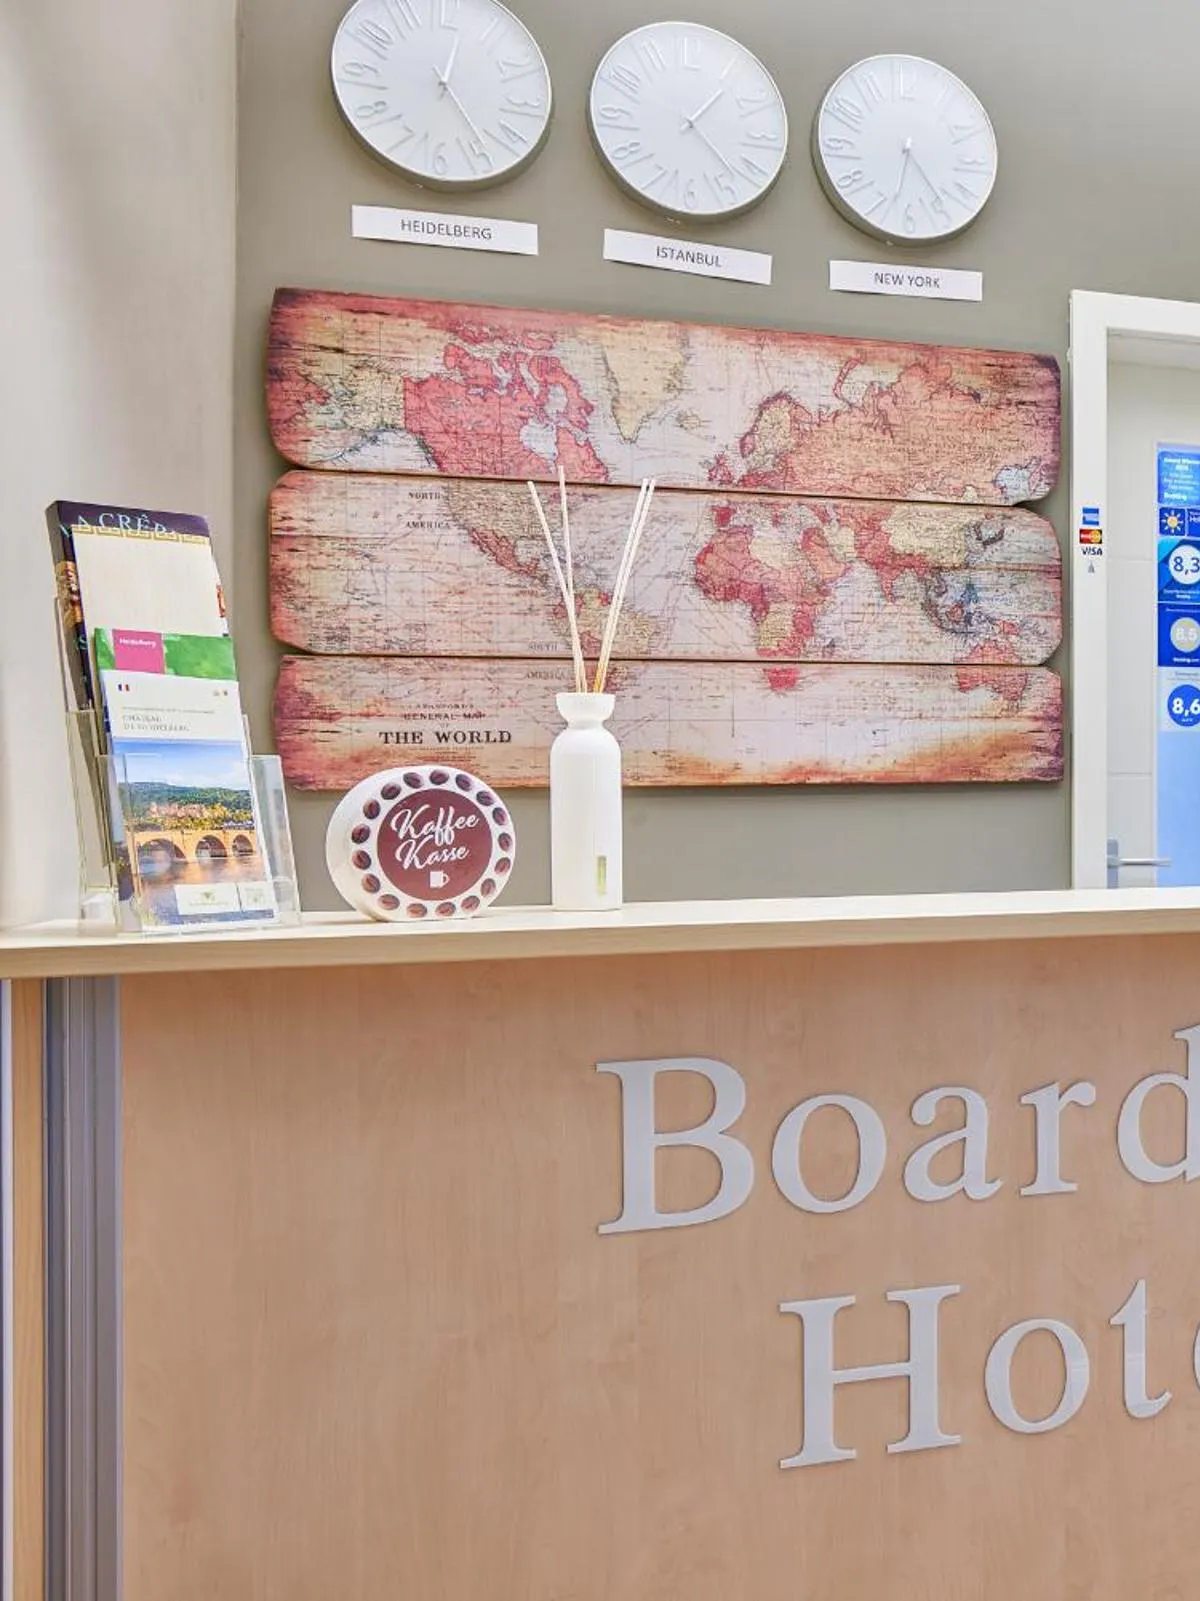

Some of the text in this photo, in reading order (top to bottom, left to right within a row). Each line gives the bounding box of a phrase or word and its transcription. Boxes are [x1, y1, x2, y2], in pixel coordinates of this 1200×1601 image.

[400, 218, 493, 241] HEIDELBERG
[656, 244, 722, 268] ISTANBUL
[874, 271, 941, 289] NEW YORK
[98, 512, 180, 536] CRÊP
[1081, 546, 1103, 556] VISA
[1173, 556, 1200, 575] 8,3
[379, 730, 512, 745] THE WORLD
[391, 804, 480, 847] Kaffee
[395, 834, 471, 870] Kasse
